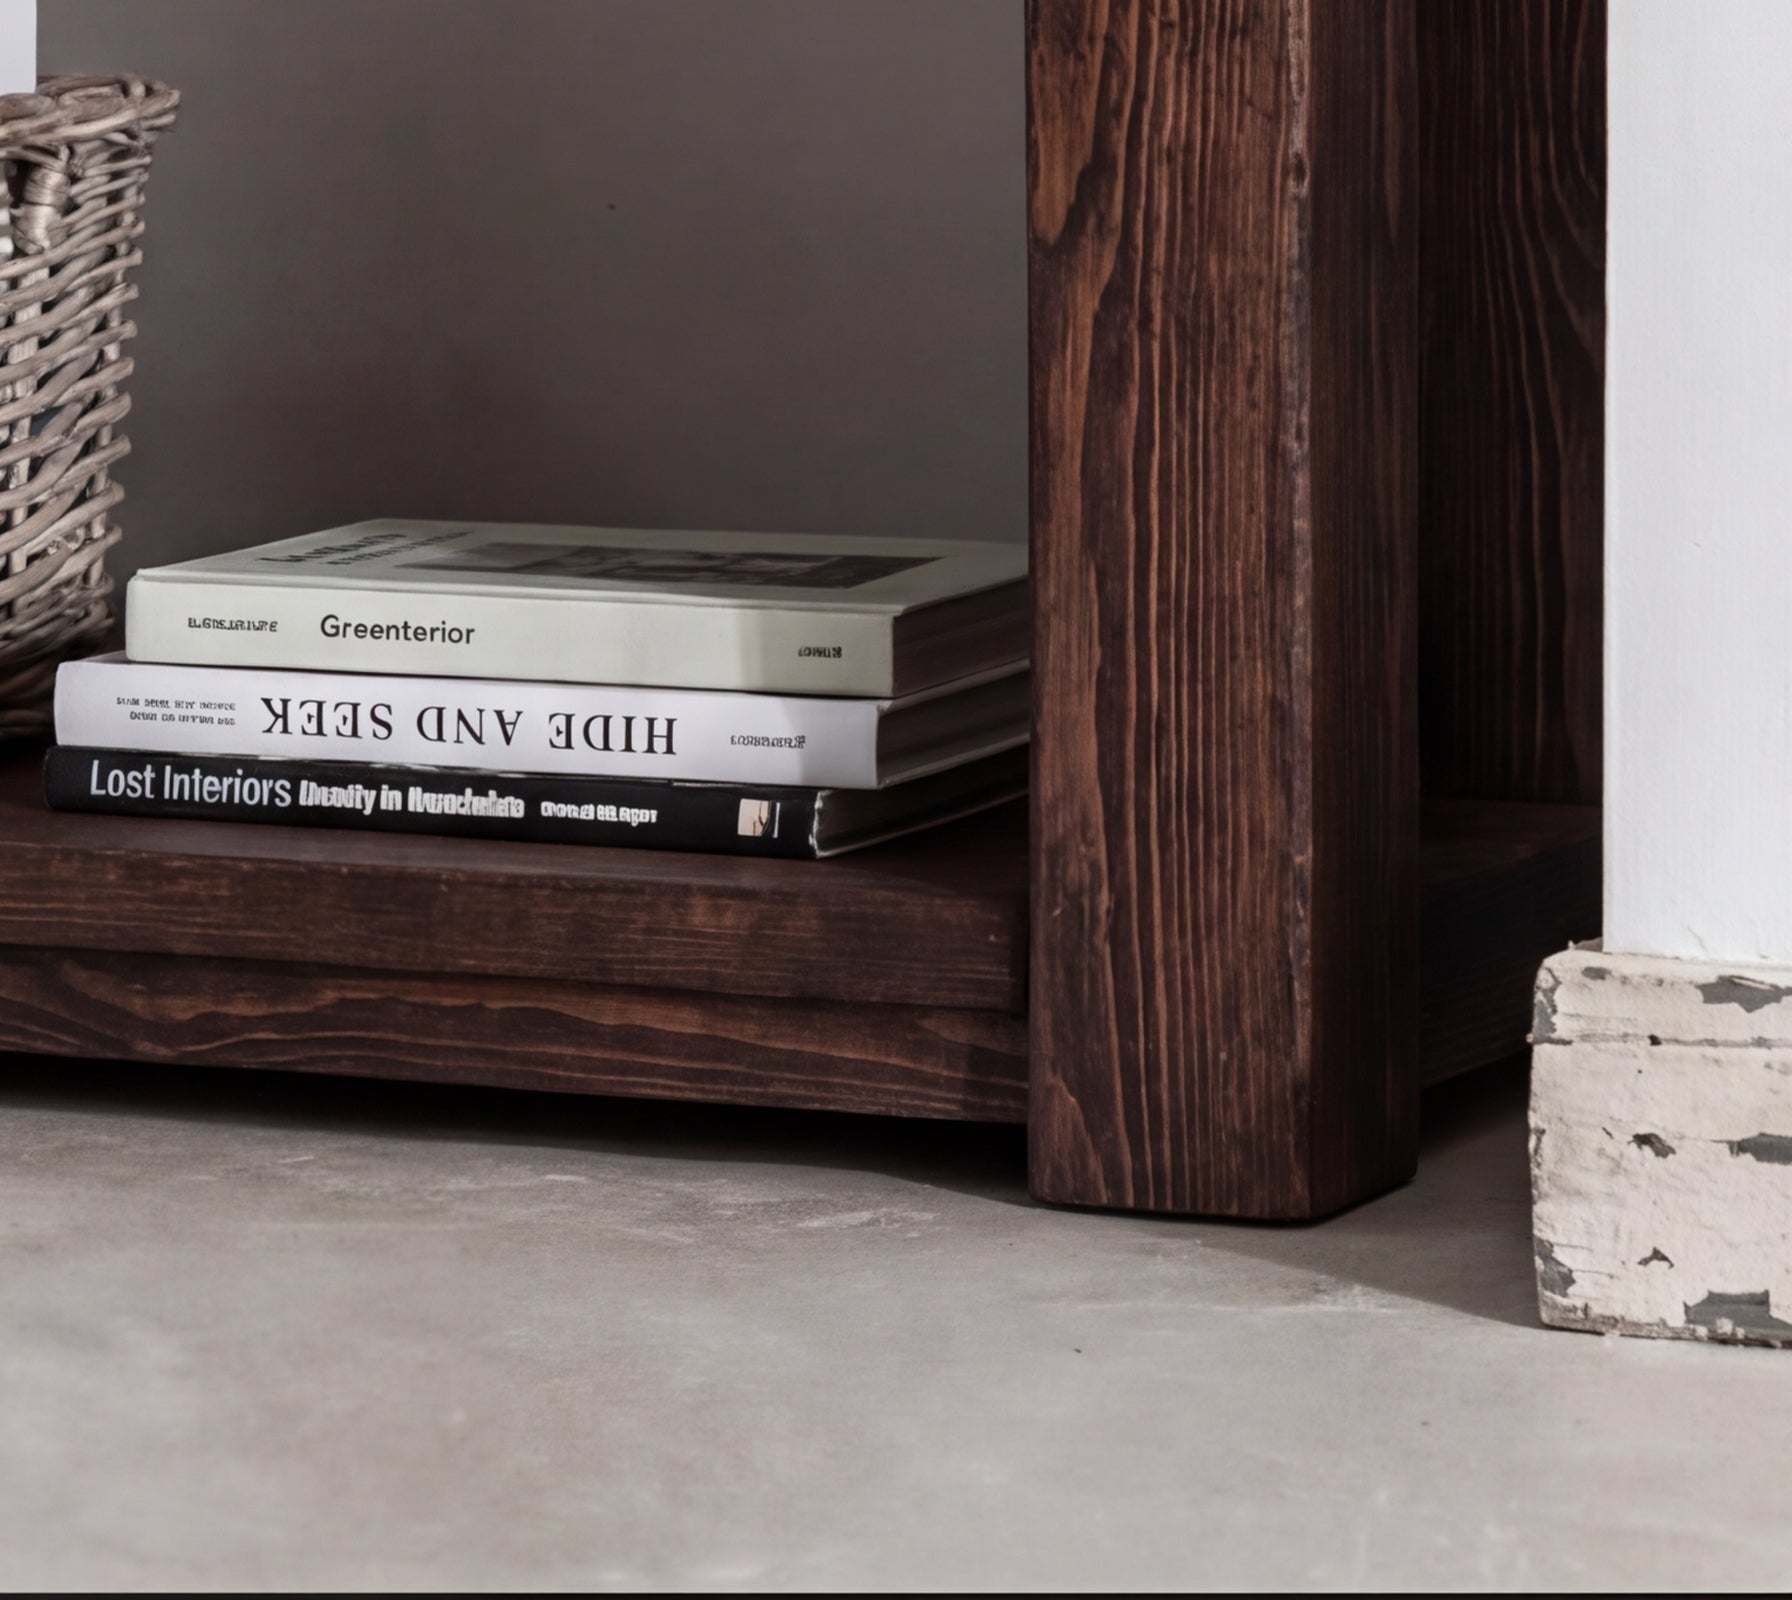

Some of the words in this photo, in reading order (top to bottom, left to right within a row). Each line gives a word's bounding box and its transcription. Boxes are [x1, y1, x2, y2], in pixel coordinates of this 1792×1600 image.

[319, 613, 477, 645] Greenterior
[260, 696, 394, 741] SEEK
[416, 705, 524, 747] AND
[548, 712, 678, 756] HIDE
[90, 759, 157, 799] Lost
[163, 764, 292, 808] Interiors
